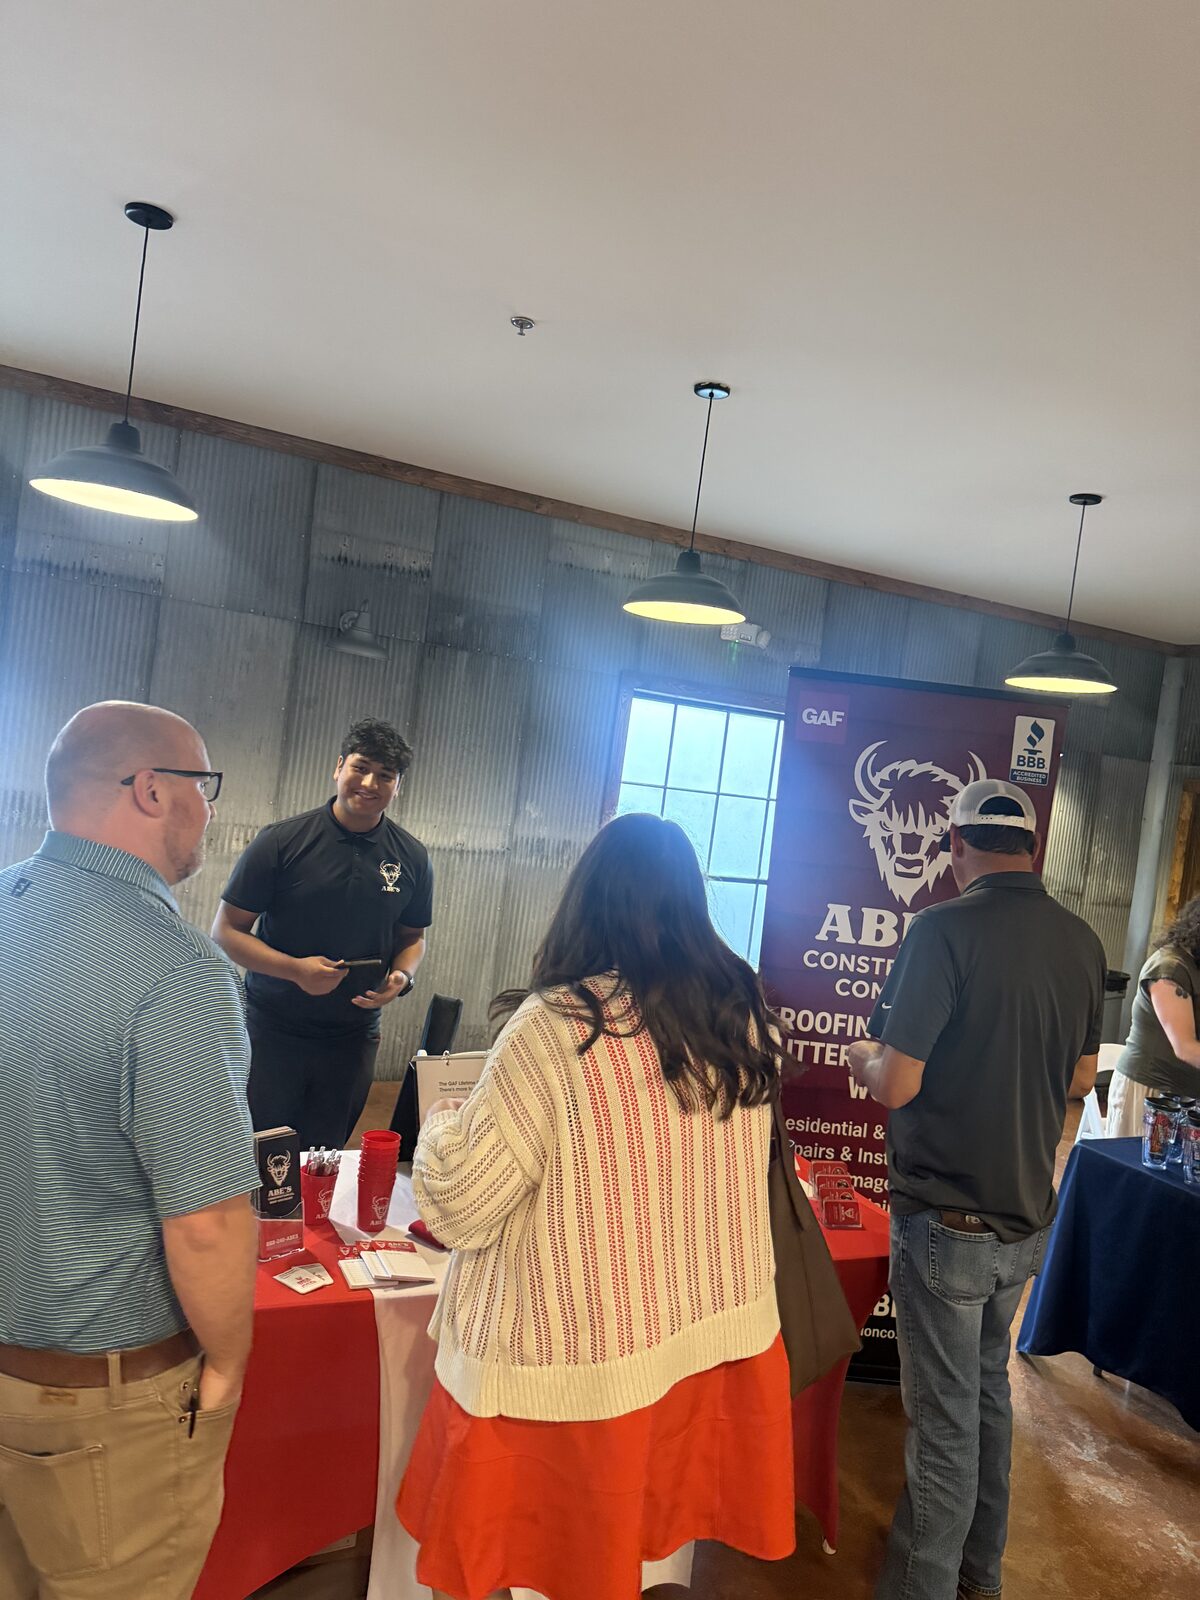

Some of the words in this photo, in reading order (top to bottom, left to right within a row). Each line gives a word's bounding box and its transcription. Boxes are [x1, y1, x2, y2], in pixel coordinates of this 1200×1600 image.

[802, 707, 845, 727] GAF
[1016, 755, 1046, 769] BBB
[1012, 770, 1047, 779] ACCREDITED
[1016, 776, 1043, 784] BUSINESS
[785, 1117, 868, 1139] esidential
[872, 1124, 886, 1141] &
[840, 1146, 853, 1162] &
[267, 1185, 293, 1197] ABE'S
